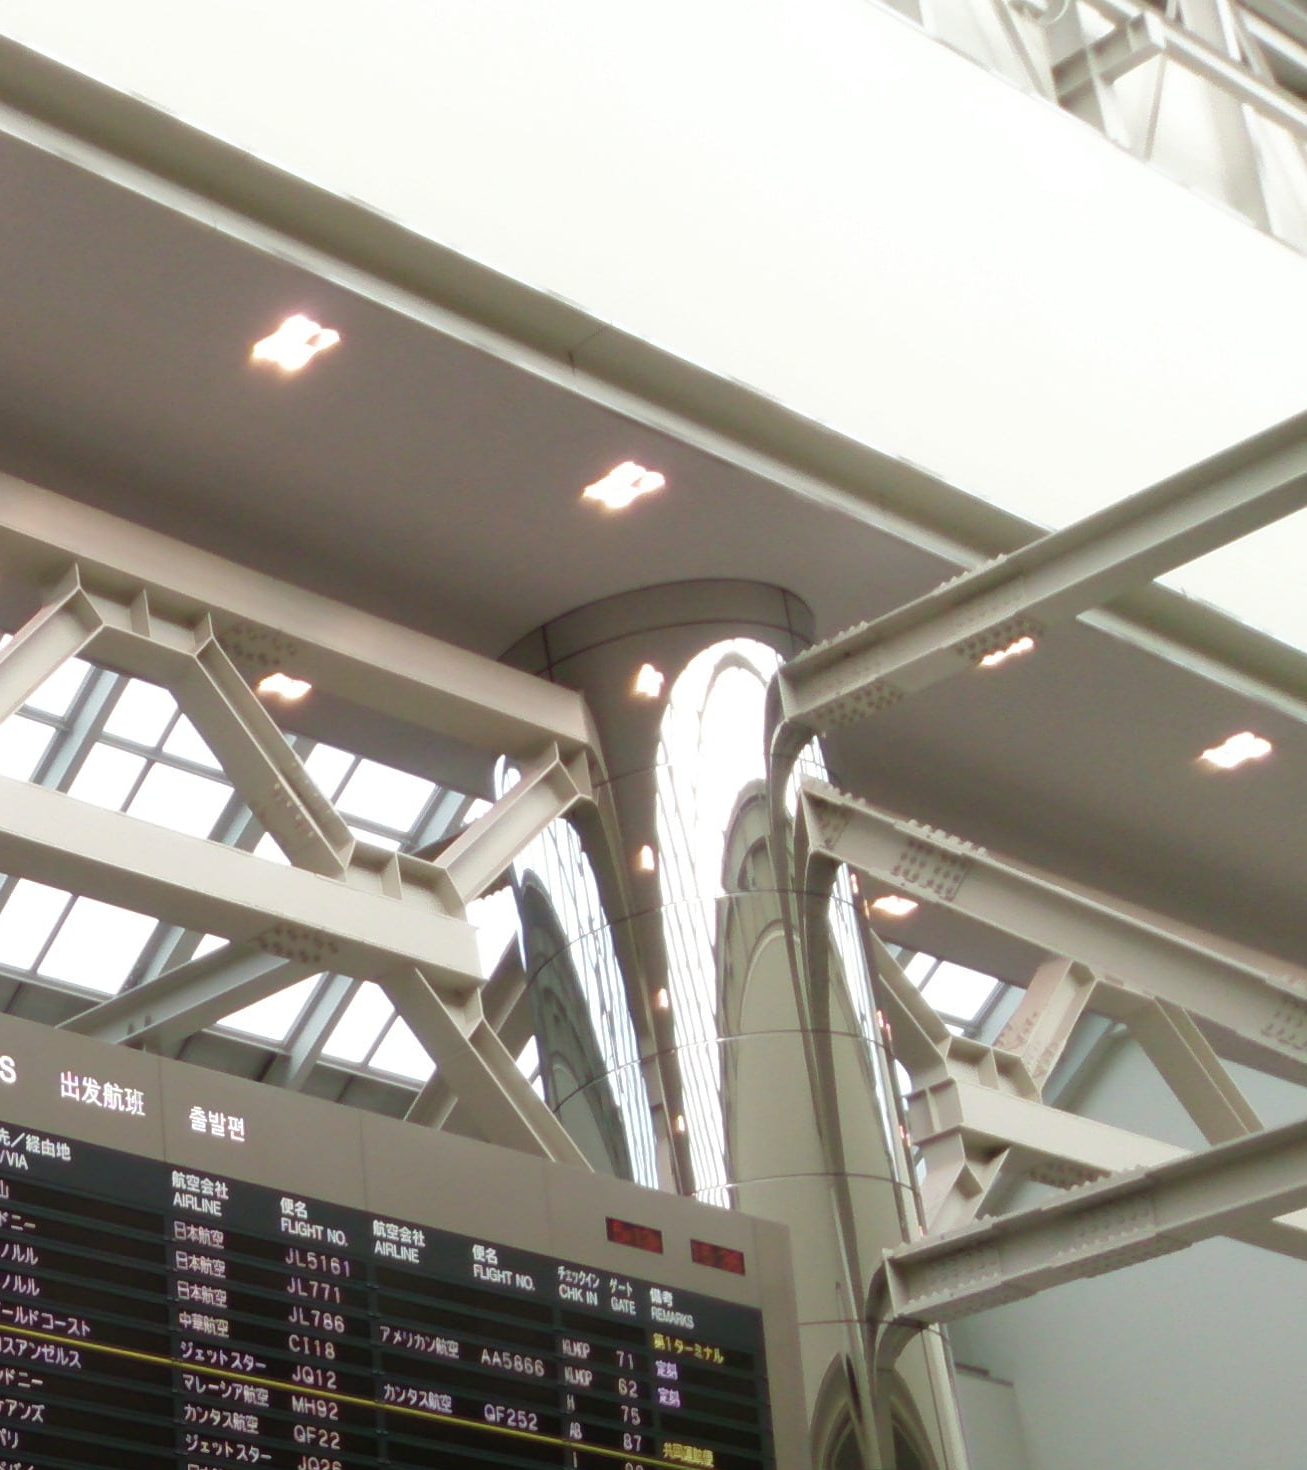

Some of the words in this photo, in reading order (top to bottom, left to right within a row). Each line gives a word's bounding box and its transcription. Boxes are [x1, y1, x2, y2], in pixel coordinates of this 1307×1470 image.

[60, 1070, 146, 1117] 出发航班
[188, 1105, 247, 1143] 출발편
[173, 1219, 225, 1250] 日本航空
[284, 1247, 351, 1278] JL5161
[287, 1333, 336, 1361] CI18
